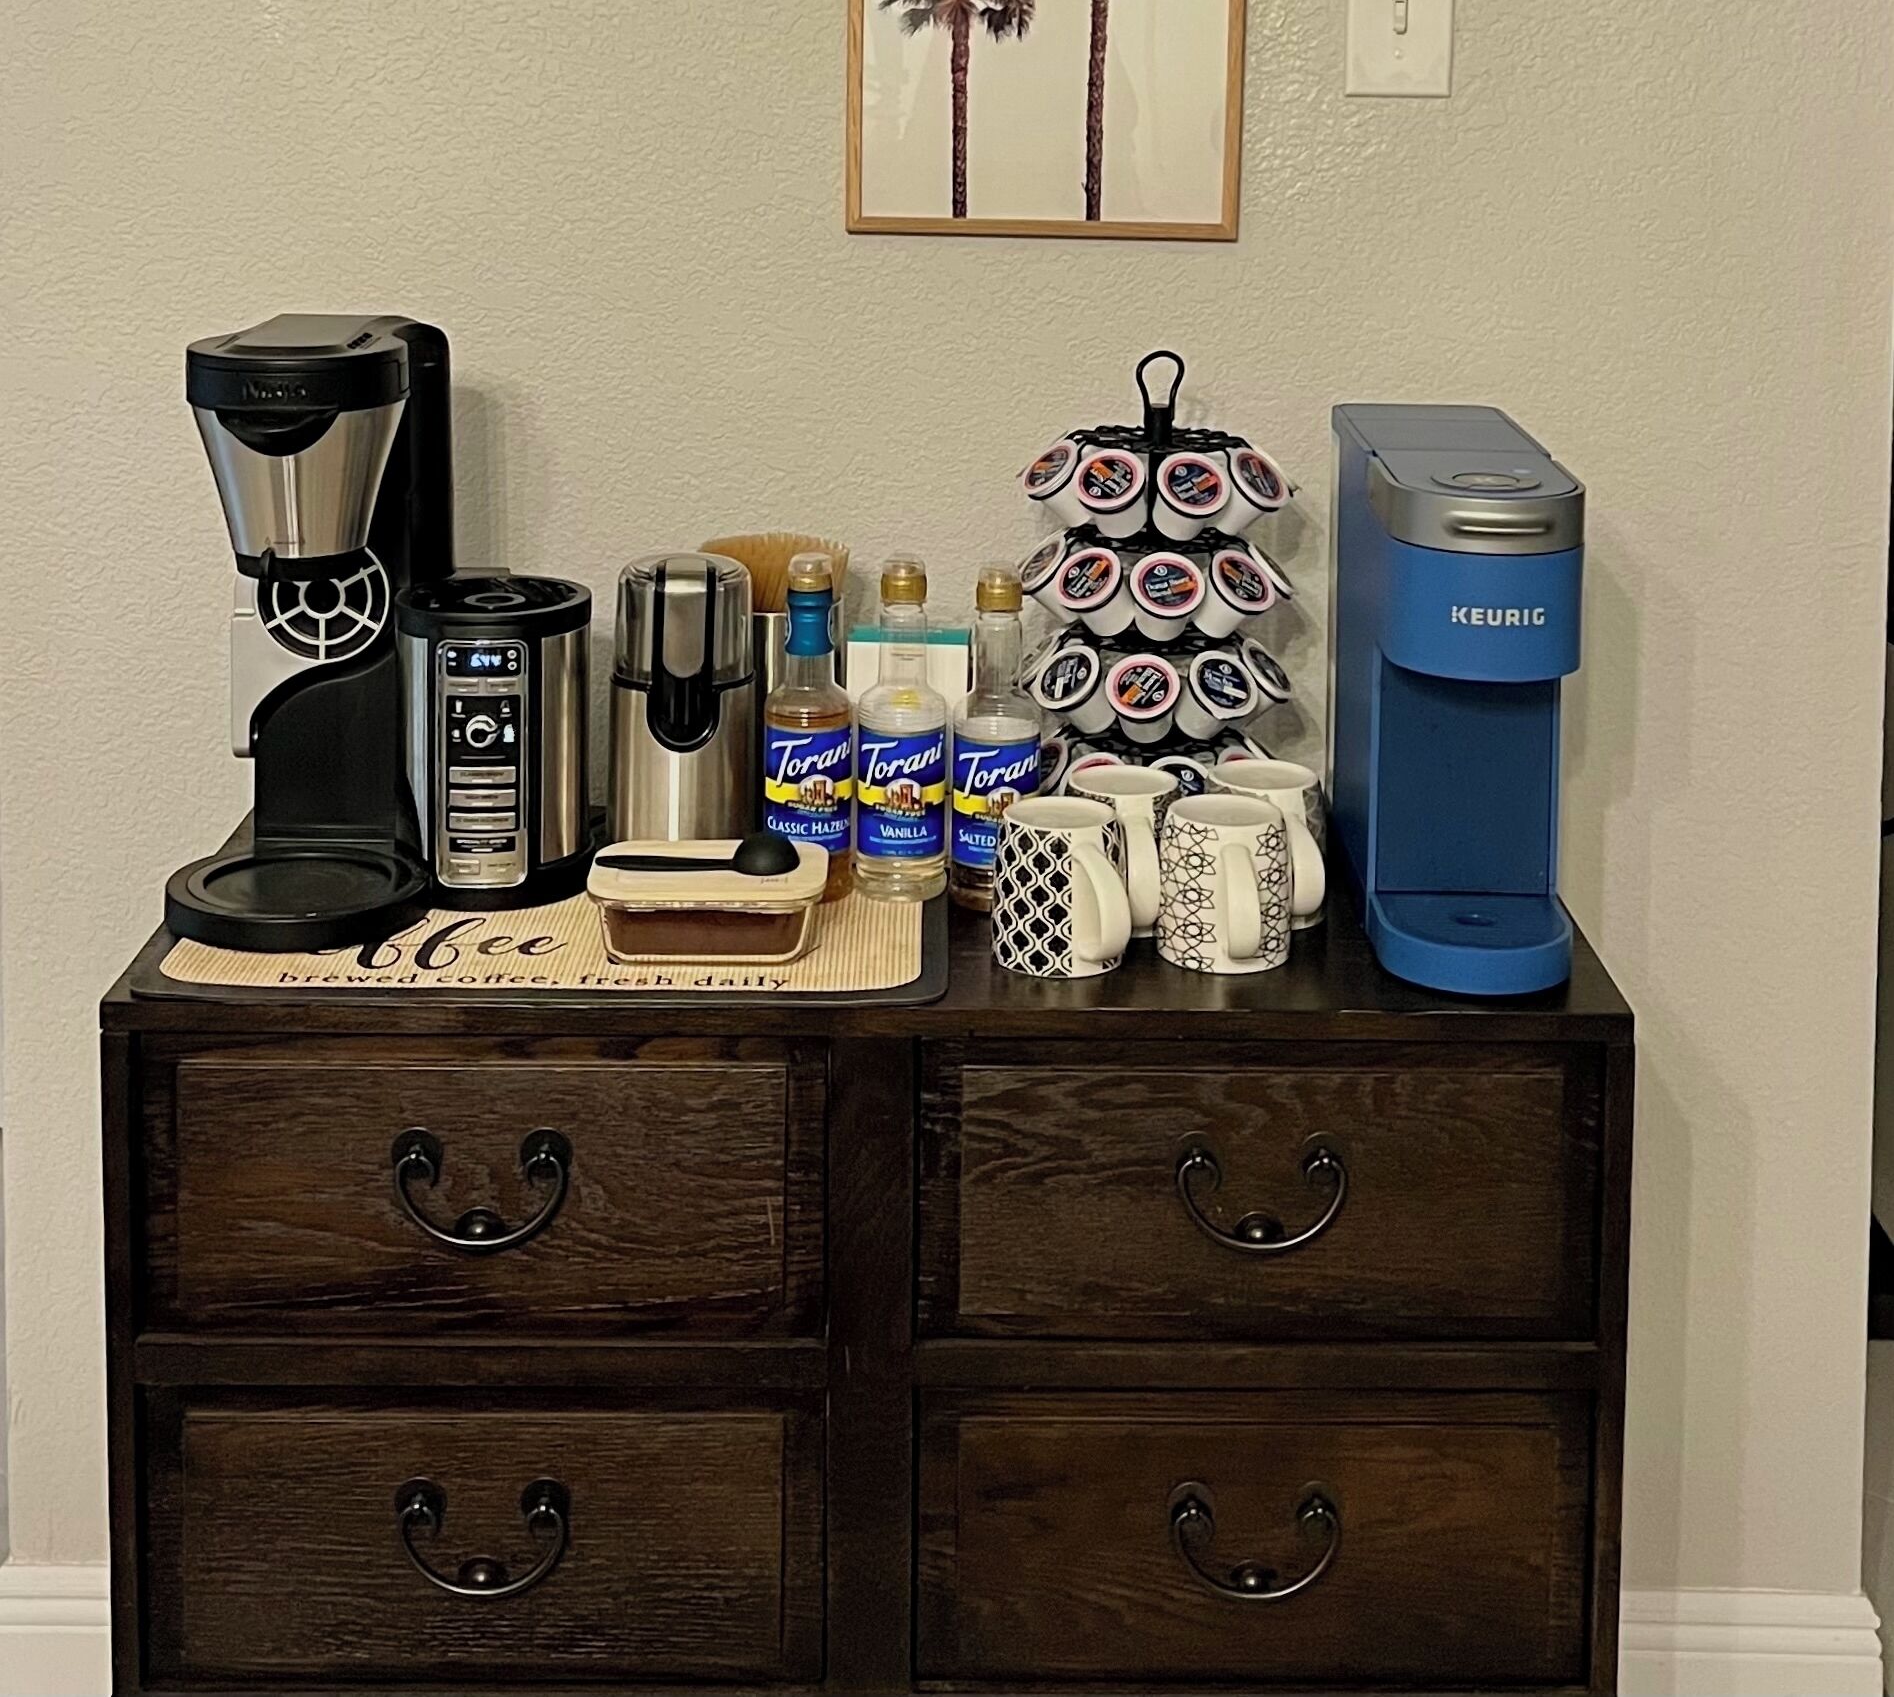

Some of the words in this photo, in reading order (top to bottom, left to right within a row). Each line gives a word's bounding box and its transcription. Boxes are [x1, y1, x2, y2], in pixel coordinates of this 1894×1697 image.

[1451, 605, 1545, 626] KEURIG
[771, 730, 852, 788] Torani
[861, 734, 944, 790] Torani
[767, 815, 808, 836] CLASSIC
[879, 823, 928, 839] VANILLA
[958, 828, 997, 848] SALTED
[308, 917, 568, 971] ffee
[278, 972, 418, 985] brewed
[436, 973, 560, 985] coffee,
[579, 974, 673, 986] fresh
[694, 975, 789, 990] daily
